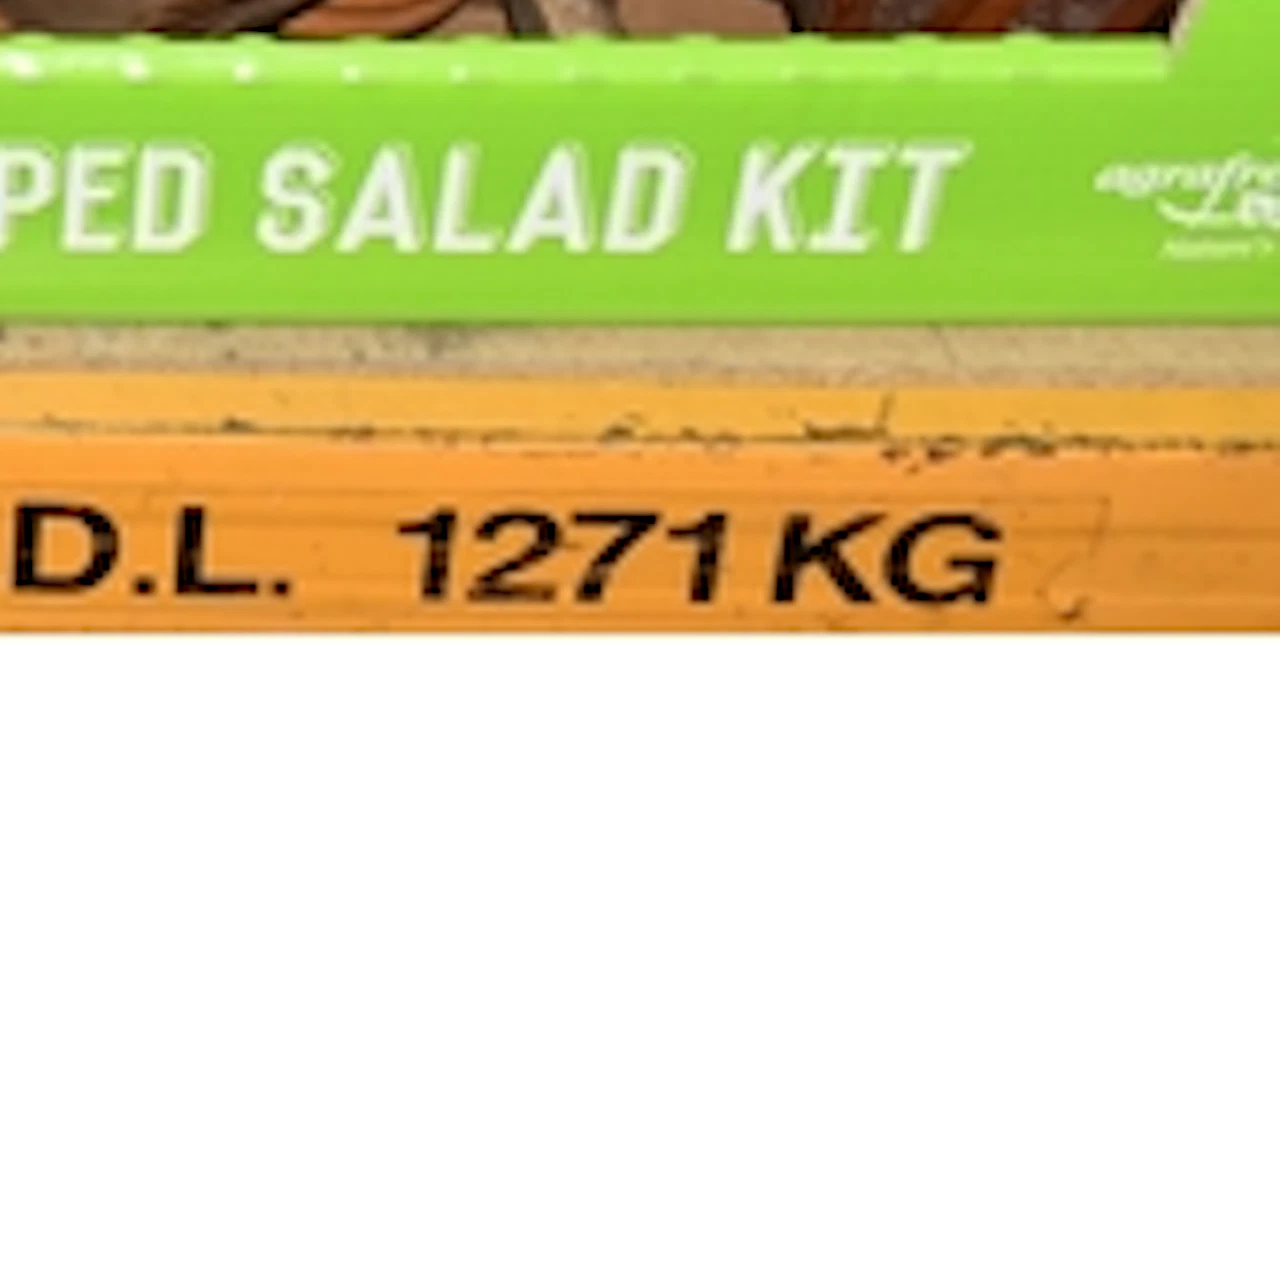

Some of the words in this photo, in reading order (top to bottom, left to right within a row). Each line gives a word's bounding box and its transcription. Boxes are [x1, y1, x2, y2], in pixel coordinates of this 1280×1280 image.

[255, 142, 692, 254] SALAD
[724, 141, 973, 254] KIT
[397, 506, 729, 604] 1271
[768, 511, 1005, 604] KG
